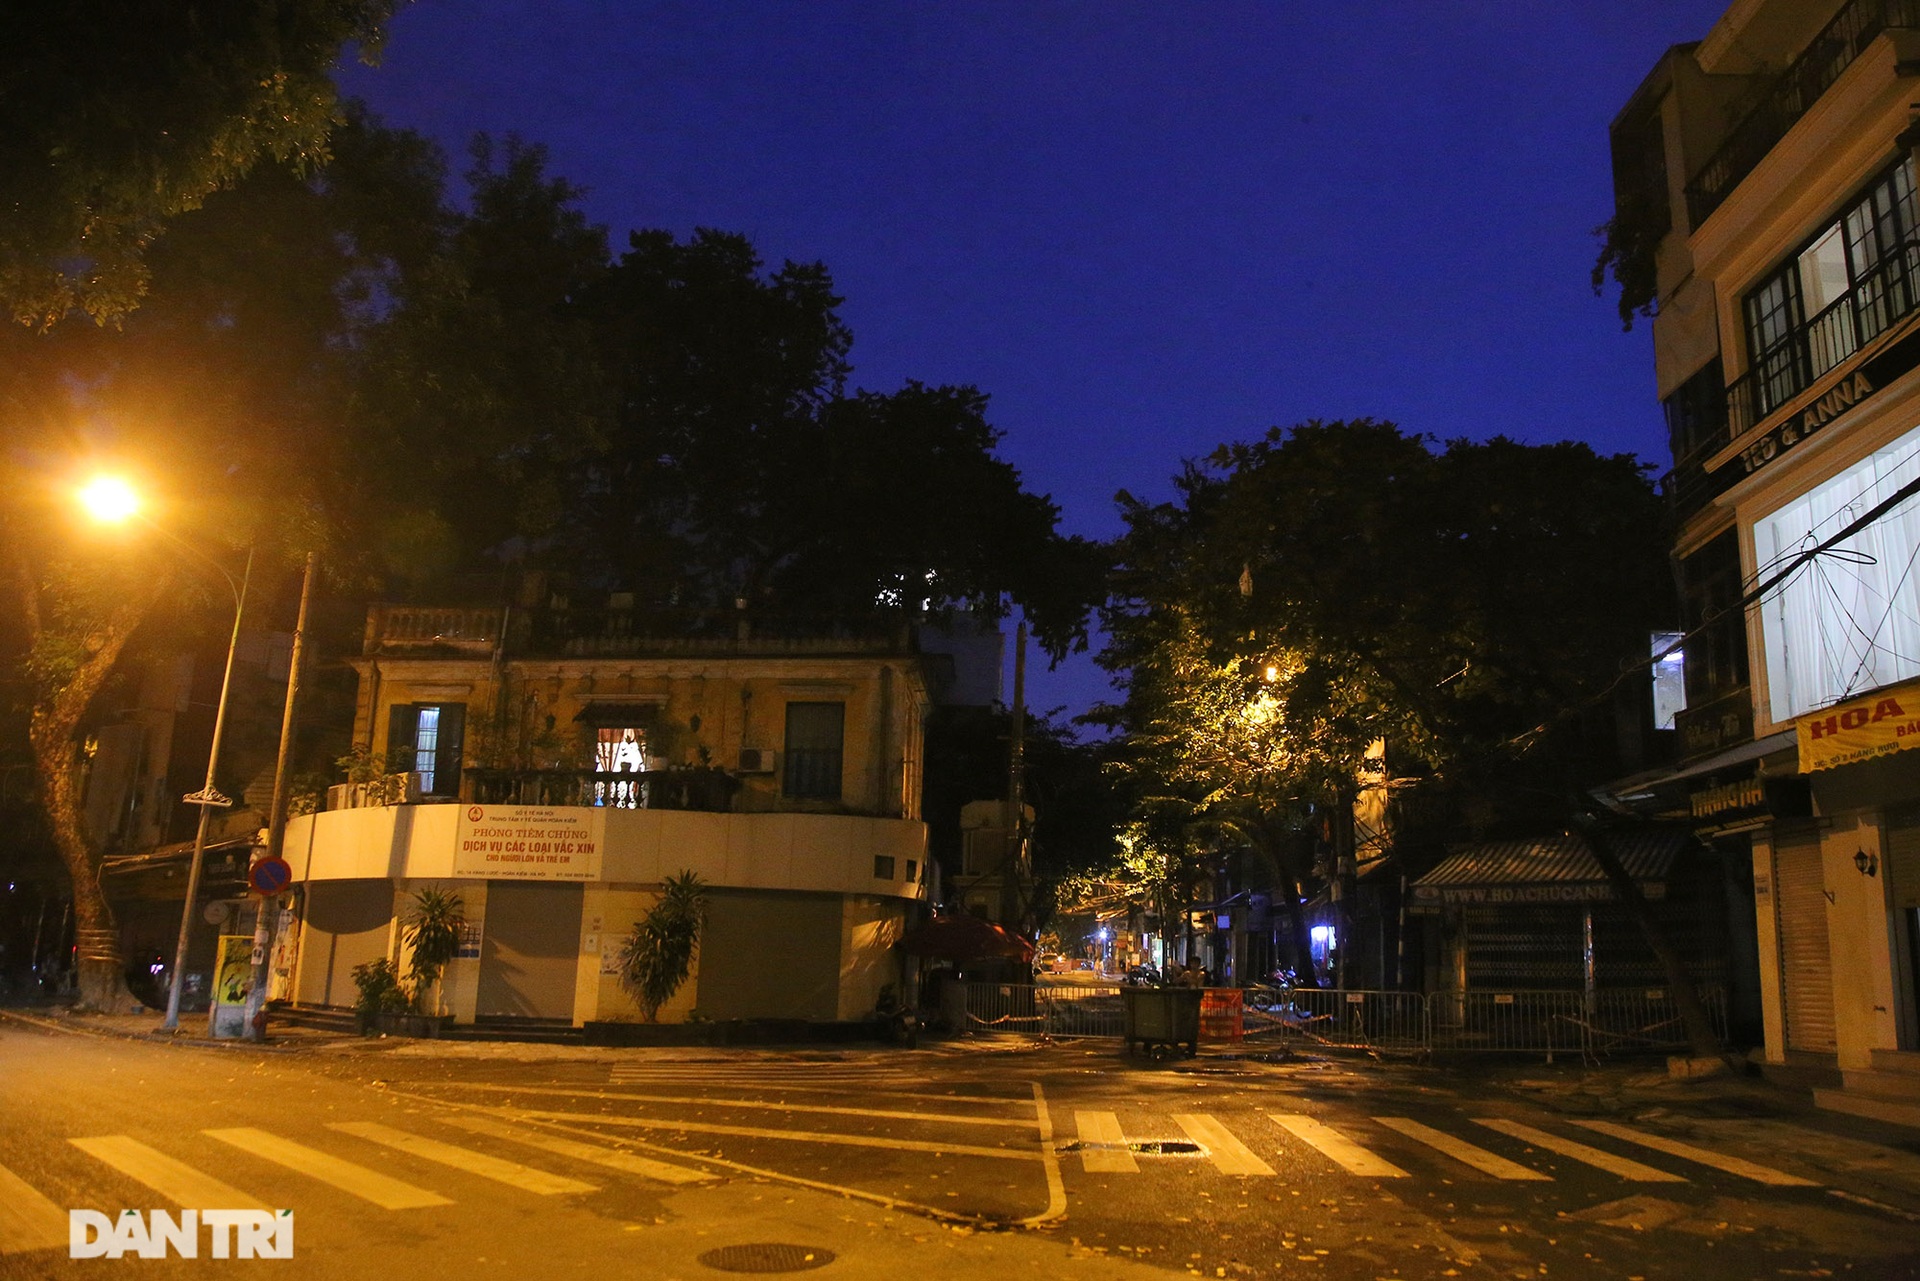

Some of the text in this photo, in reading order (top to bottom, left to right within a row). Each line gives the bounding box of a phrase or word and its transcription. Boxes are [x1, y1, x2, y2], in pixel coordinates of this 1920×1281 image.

[1740, 371, 1873, 473] TED & ANNA
[1810, 698, 1905, 740] HOA
[473, 827, 513, 837] PHÒNG
[463, 840, 487, 853] DỊCH
[490, 841, 503, 854] VỤ
[505, 840, 526, 852] CÁC
[528, 842, 551, 854] LOẠI
[576, 843, 595, 854] XIN
